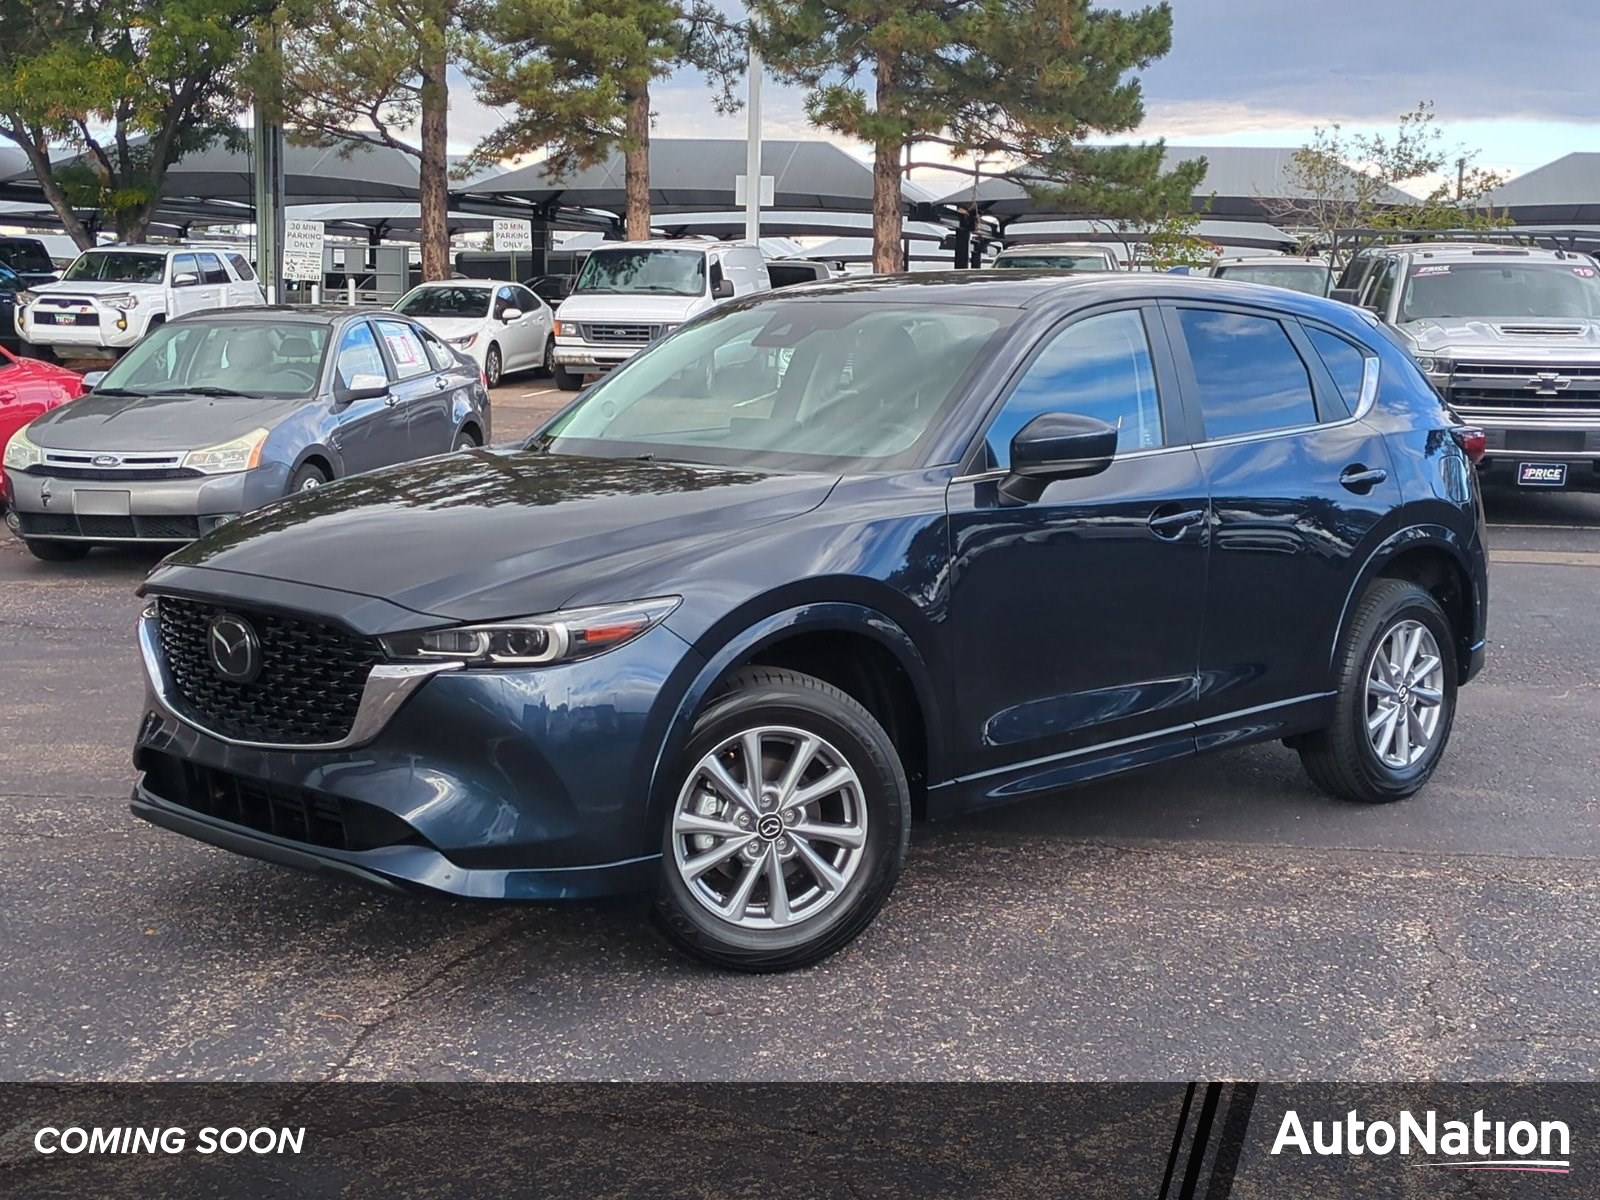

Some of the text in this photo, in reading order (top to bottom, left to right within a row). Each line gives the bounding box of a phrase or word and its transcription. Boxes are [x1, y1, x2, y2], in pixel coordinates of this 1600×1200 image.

[290, 222, 301, 230] 30
[498, 222, 509, 230] 30
[287, 231, 322, 240] PARKING
[495, 231, 530, 239] PARKING
[293, 240, 315, 249] ONLY
[502, 241, 523, 249] ONLY
